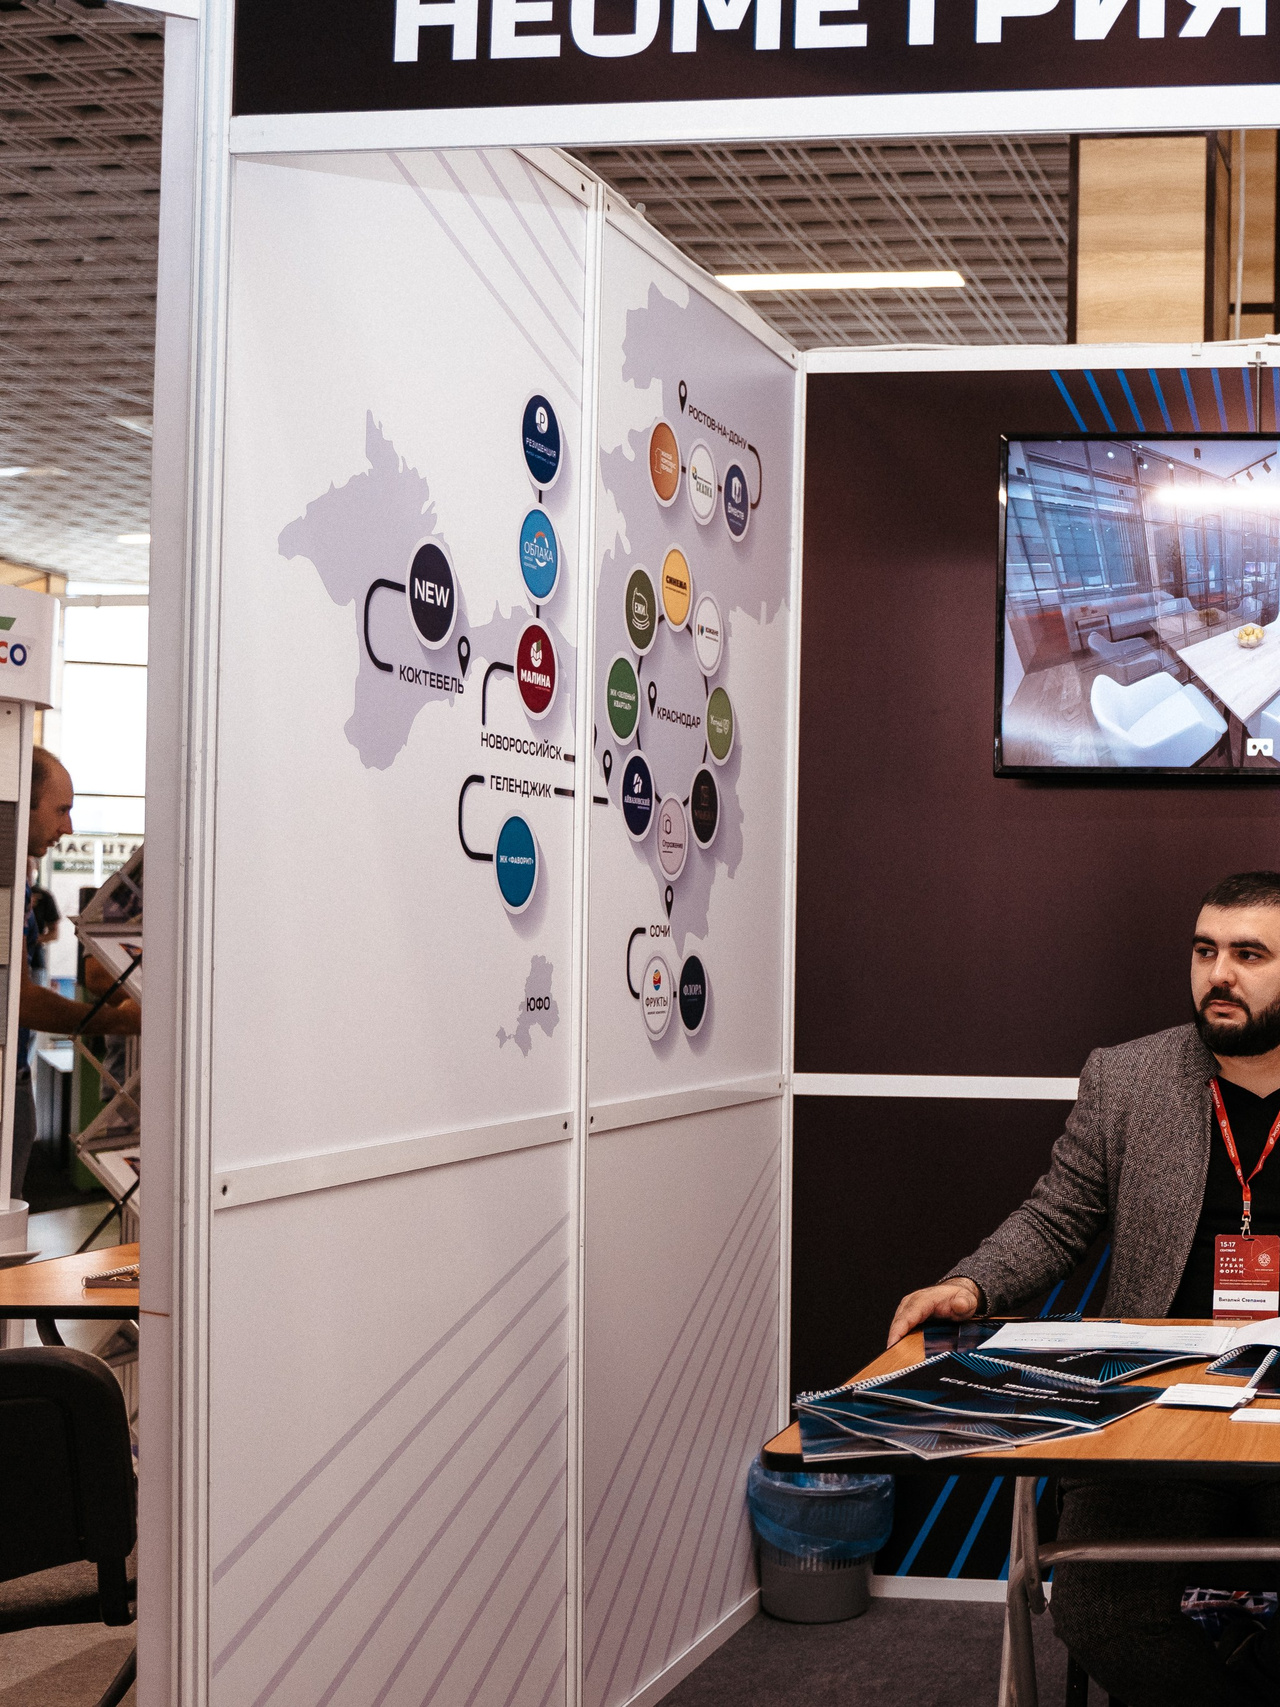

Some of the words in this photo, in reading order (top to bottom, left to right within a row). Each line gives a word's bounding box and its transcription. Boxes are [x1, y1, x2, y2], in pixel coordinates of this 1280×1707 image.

[688, 404, 747, 450] РОСТОВ-НА-ДОНУ
[523, 541, 554, 563] ОБЛАКА
[414, 577, 450, 608] NEW
[399, 664, 465, 695] КОКТЕБЕЛЬ
[520, 668, 551, 688] МАЛИНА
[657, 707, 701, 728] КРАСНОДАР
[480, 731, 563, 761] НОВОРОССИЙСК
[490, 774, 552, 798] ГЕЛЕНДЖИК
[650, 925, 670, 937] СОЧИ
[526, 996, 551, 1012] ЮФО
[645, 996, 668, 1008] ФРУКТЫ
